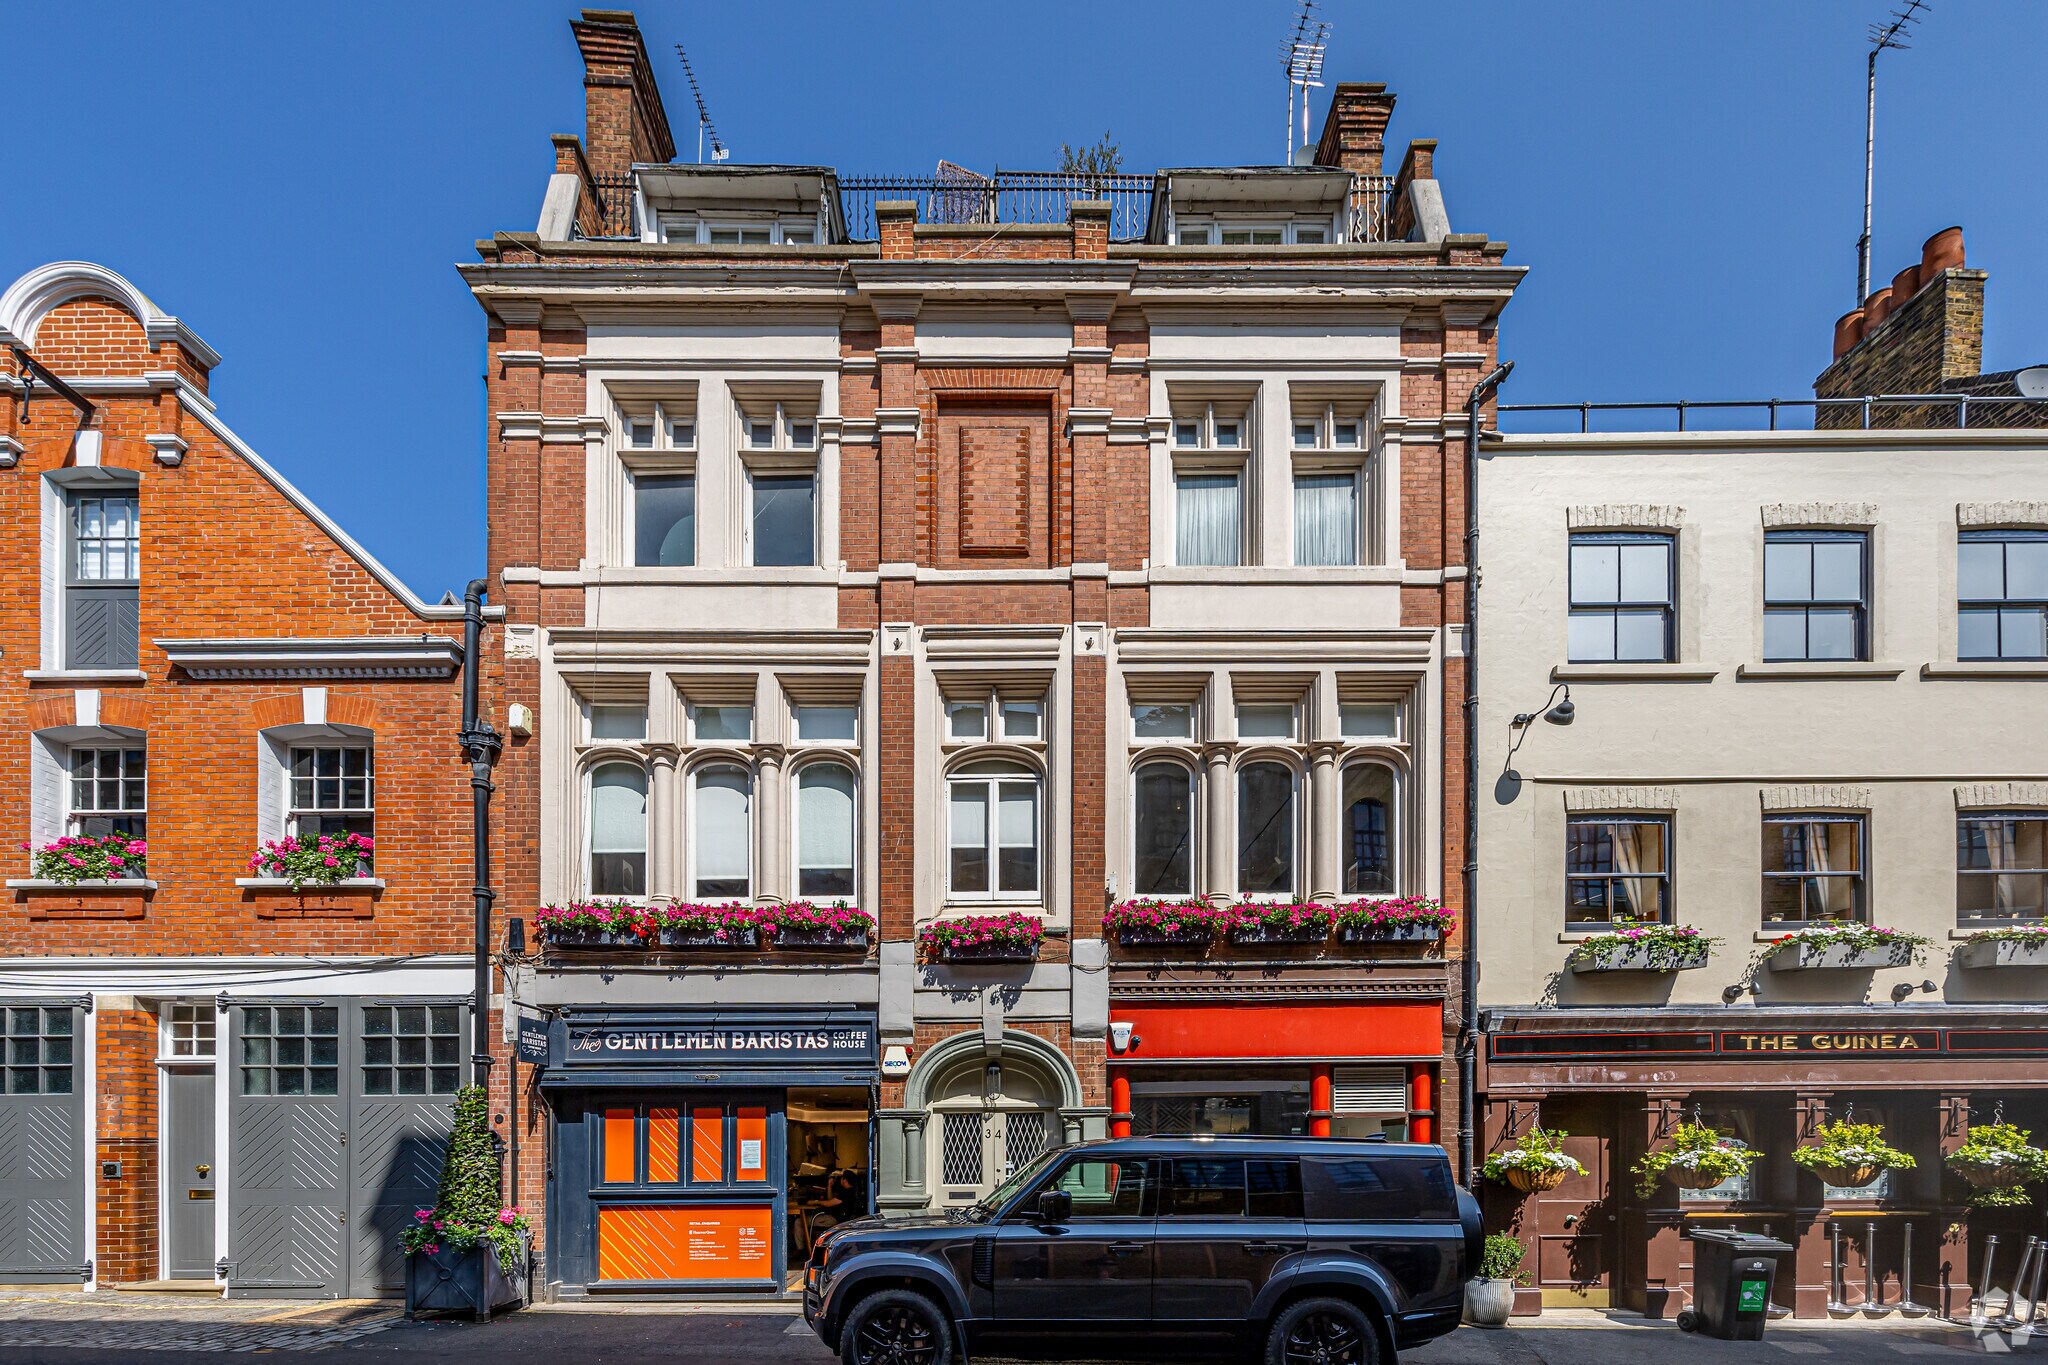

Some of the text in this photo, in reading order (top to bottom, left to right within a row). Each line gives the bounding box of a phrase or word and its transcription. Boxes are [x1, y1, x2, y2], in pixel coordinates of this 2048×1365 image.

[521, 1030, 547, 1041] GENTLEMEN
[573, 1029, 829, 1053] The GENTLEMEN BARISTAS
[832, 1031, 867, 1040] COFFEE
[521, 1036, 547, 1048] BARISTAS
[832, 1040, 866, 1049] HOUSE
[1740, 1034, 1919, 1050] THE GUINEA
[884, 1060, 907, 1068] SECOM
